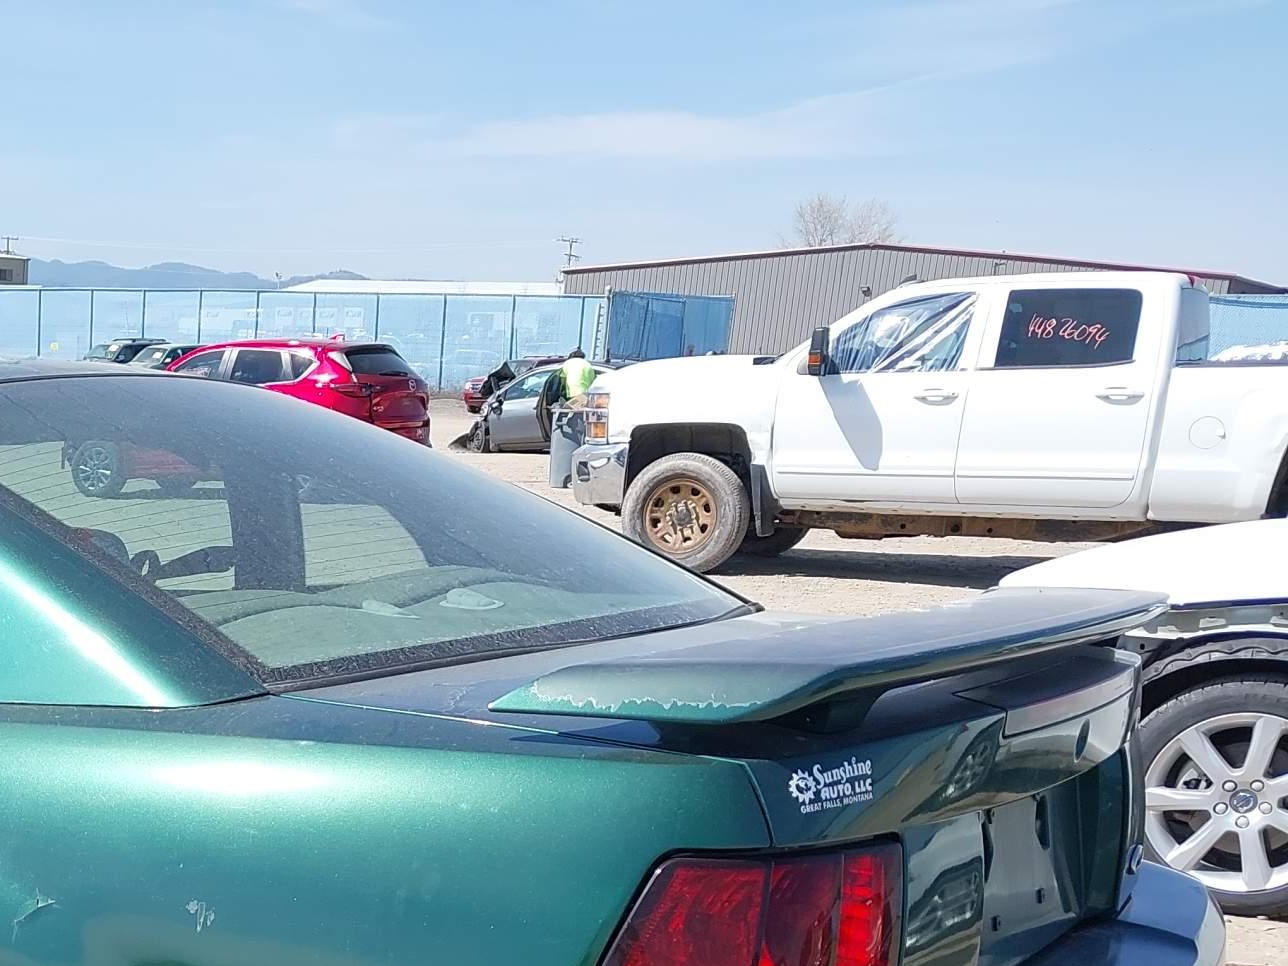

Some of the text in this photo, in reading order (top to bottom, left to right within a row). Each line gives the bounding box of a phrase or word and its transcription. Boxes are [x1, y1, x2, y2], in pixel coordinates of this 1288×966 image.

[813, 756, 872, 789] Sunshine
[855, 778, 873, 794] LLC
[800, 802, 822, 814] GREAT
[843, 792, 874, 806] MONTANA
